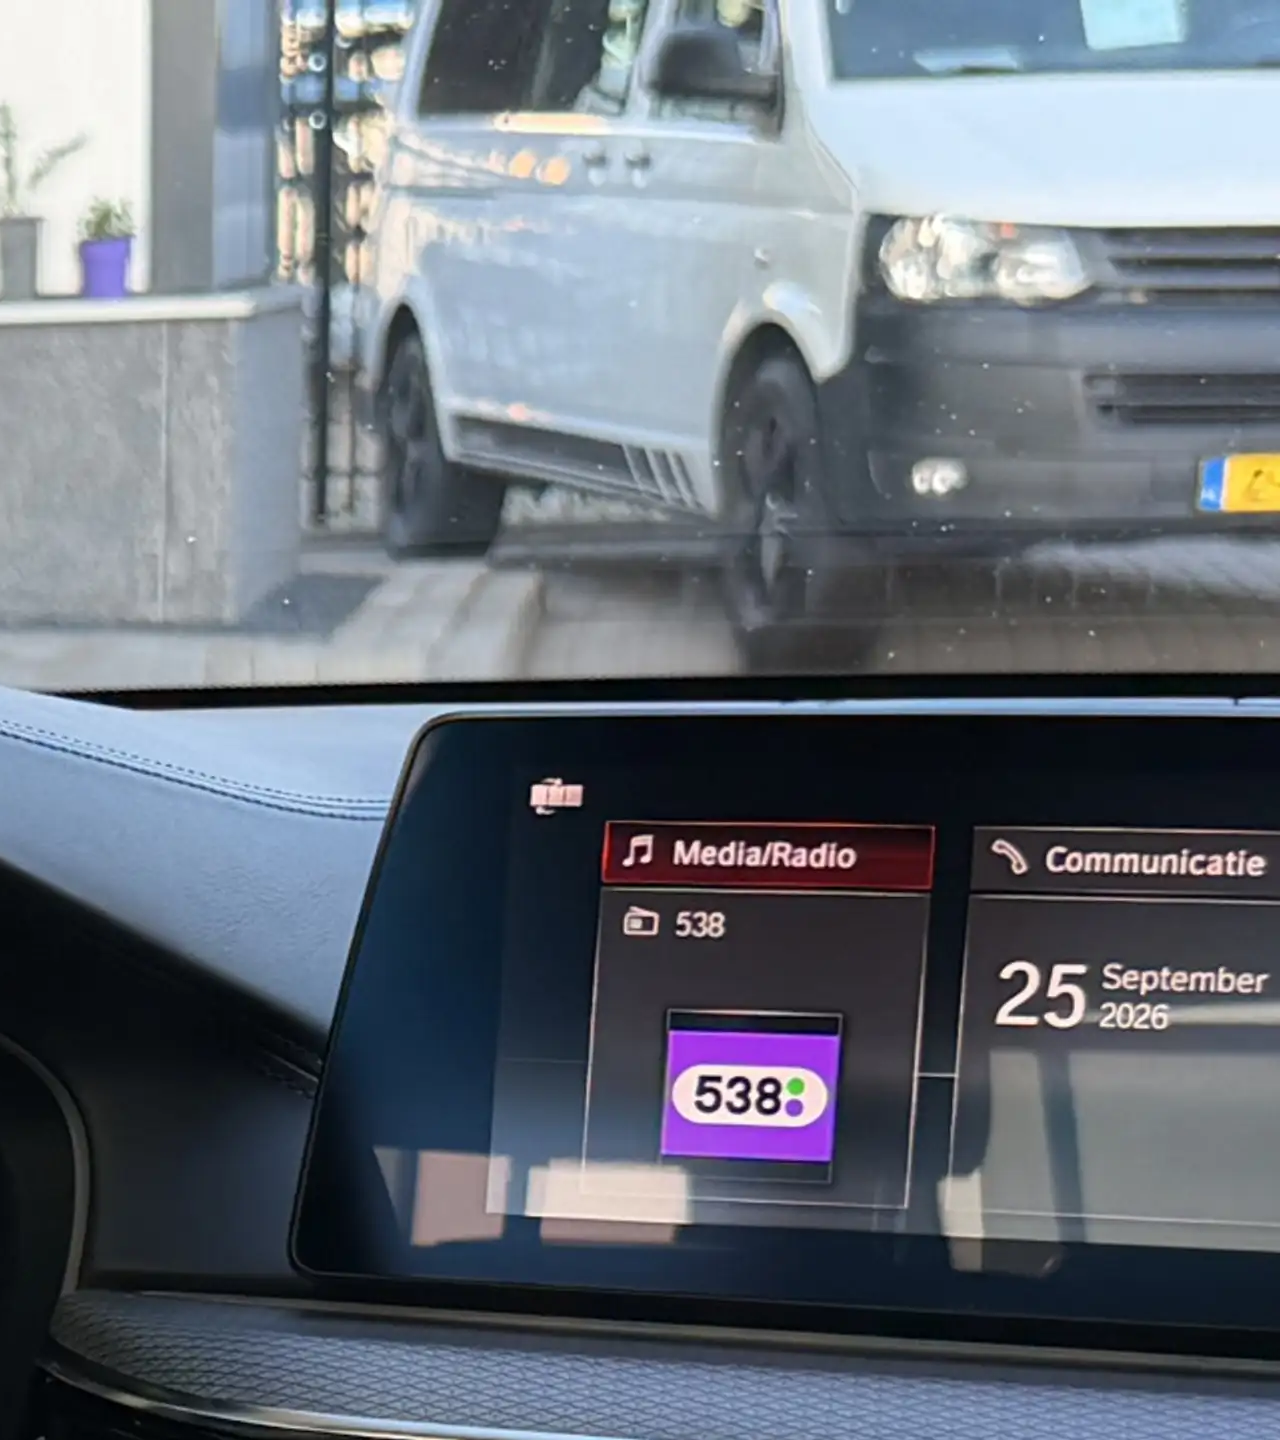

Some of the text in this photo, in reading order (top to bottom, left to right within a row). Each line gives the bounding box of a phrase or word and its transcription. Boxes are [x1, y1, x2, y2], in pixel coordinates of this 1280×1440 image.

[672, 837, 858, 871] Media/Radio
[1044, 844, 1268, 878] Communicatie
[674, 910, 726, 938] 538
[994, 959, 1089, 1030] 25
[1101, 962, 1270, 997] September
[1099, 1001, 1171, 1032] 2026
[692, 1074, 783, 1118] 538
